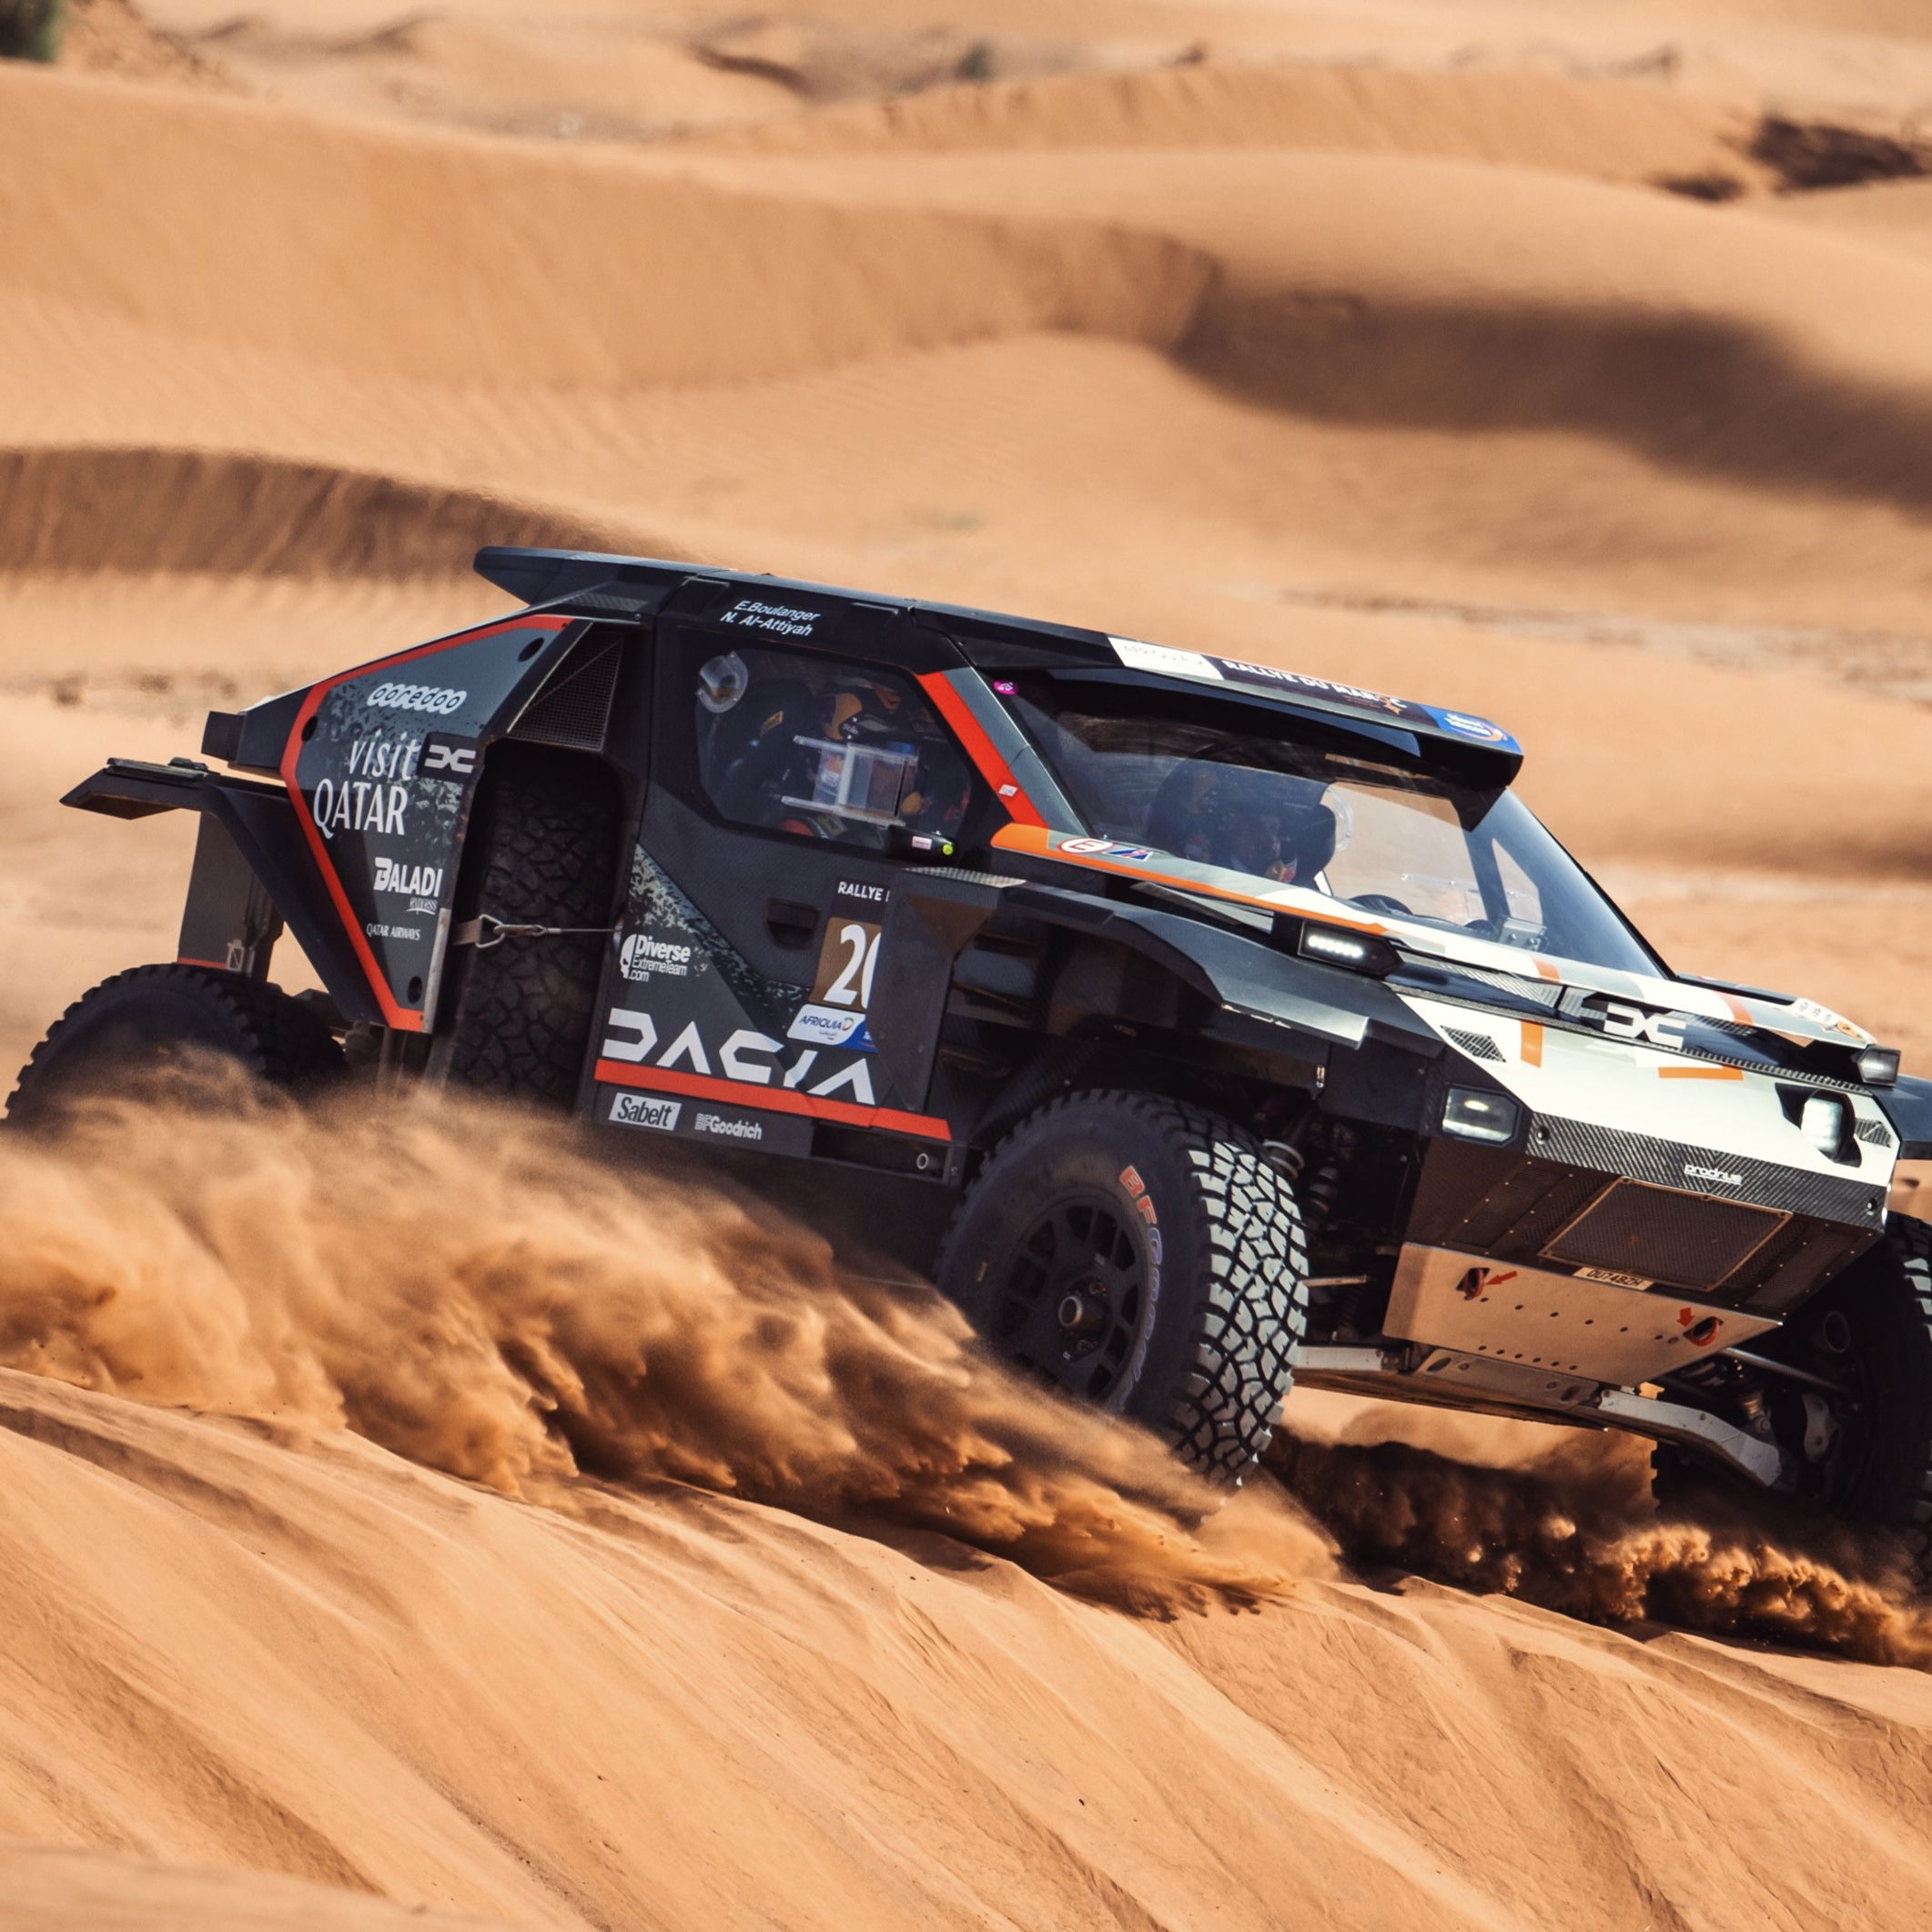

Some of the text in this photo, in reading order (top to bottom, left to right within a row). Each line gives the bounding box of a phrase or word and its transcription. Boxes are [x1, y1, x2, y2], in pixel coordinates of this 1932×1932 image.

[720, 612, 814, 636] N. Al-Attiyah
[733, 601, 821, 621] E.Boulanger
[369, 683, 465, 713] ooredoo
[349, 729, 421, 781] visit
[313, 778, 408, 839] QATAR
[373, 856, 443, 897] BALADI
[837, 881, 884, 901] RALLYE
[366, 923, 420, 941] QATAR AIRWAYS
[635, 934, 691, 963] Diverse
[799, 1015, 842, 1029] AFRIQUIA
[602, 1007, 875, 1105] DACIA
[618, 1097, 673, 1128] Sabelt
[694, 1113, 763, 1140] BFGoodrich
